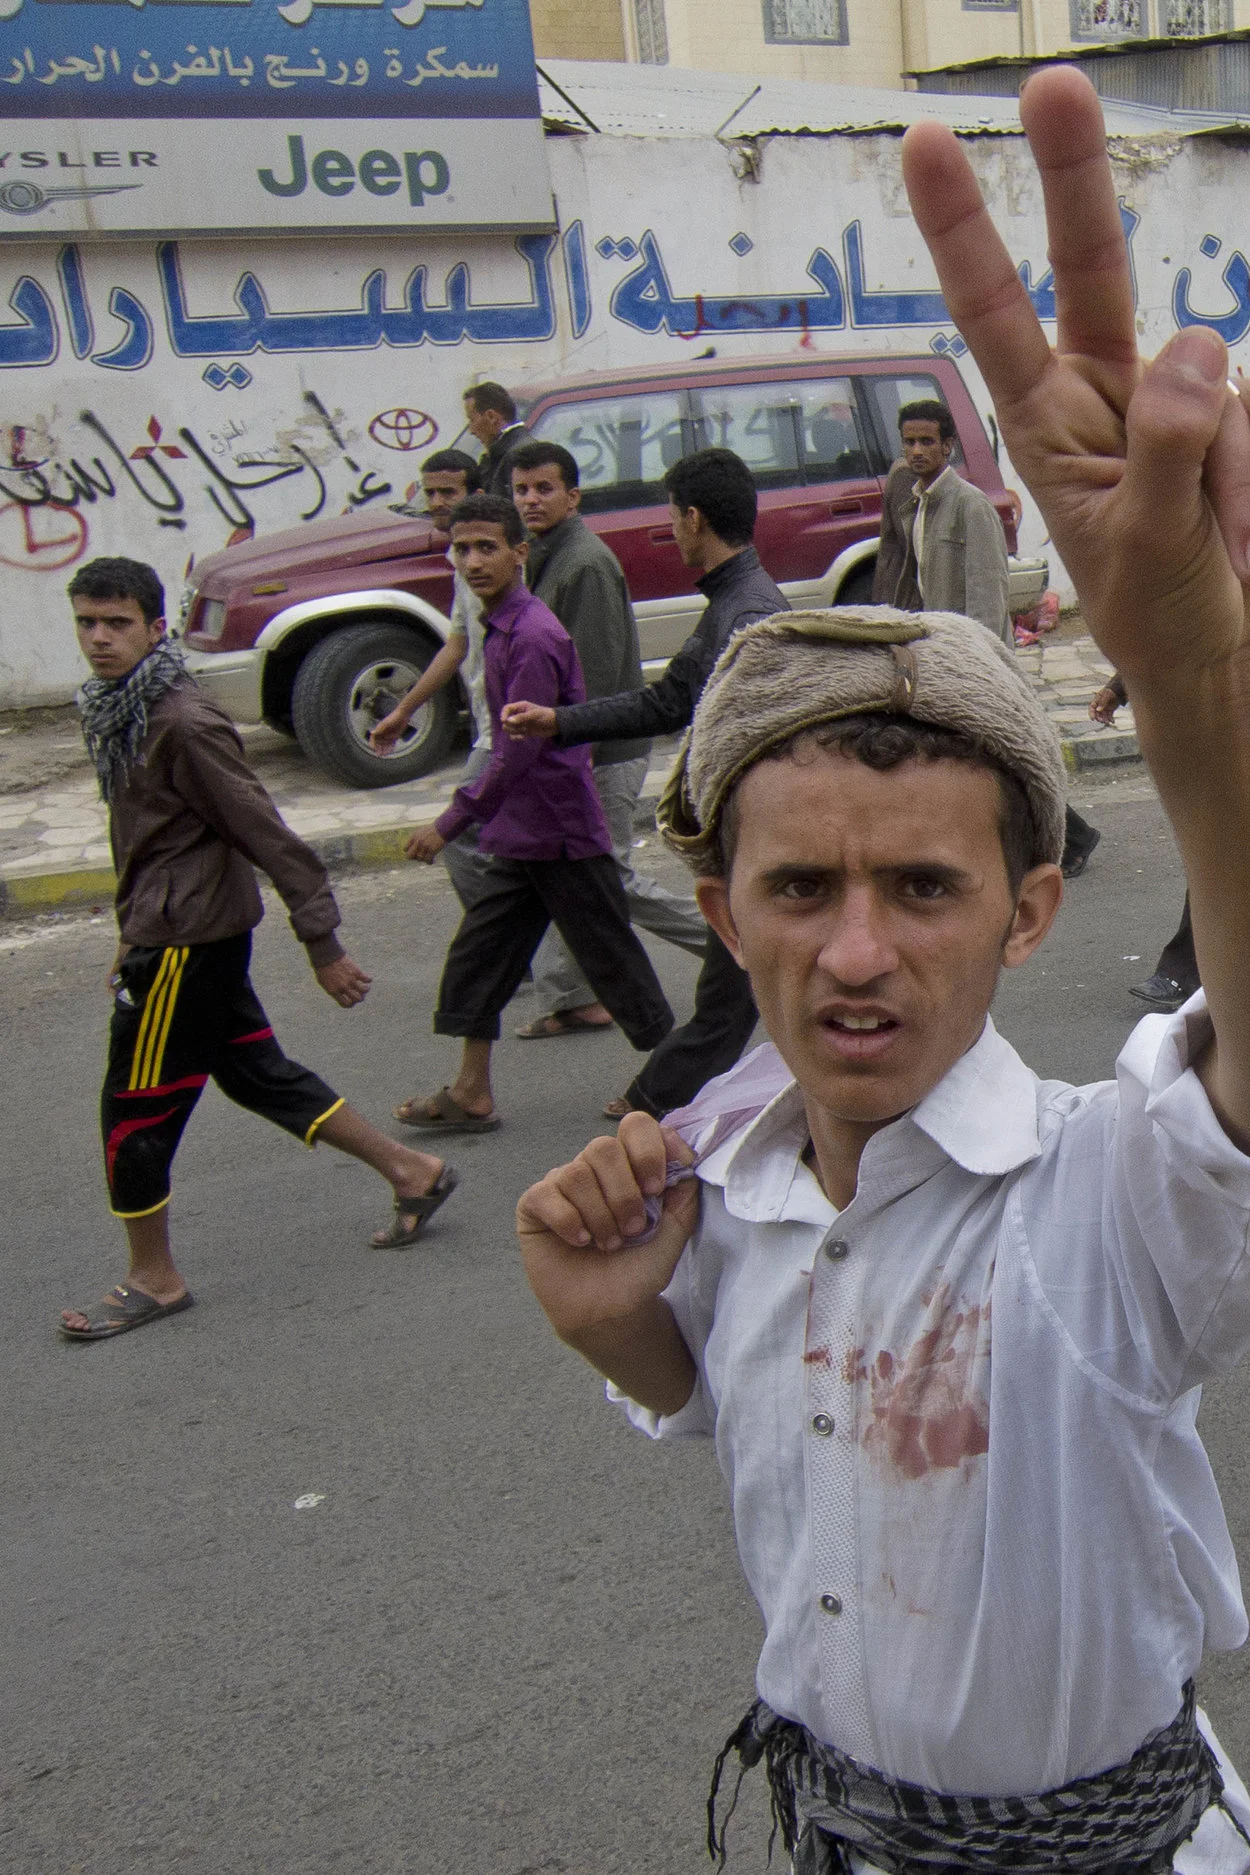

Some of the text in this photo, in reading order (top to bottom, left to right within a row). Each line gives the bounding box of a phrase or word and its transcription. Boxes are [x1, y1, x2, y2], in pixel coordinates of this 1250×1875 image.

[133, 44, 255, 86] بالفرن
[386, 46, 500, 86] سمكرة
[257, 135, 451, 207] Jeep
